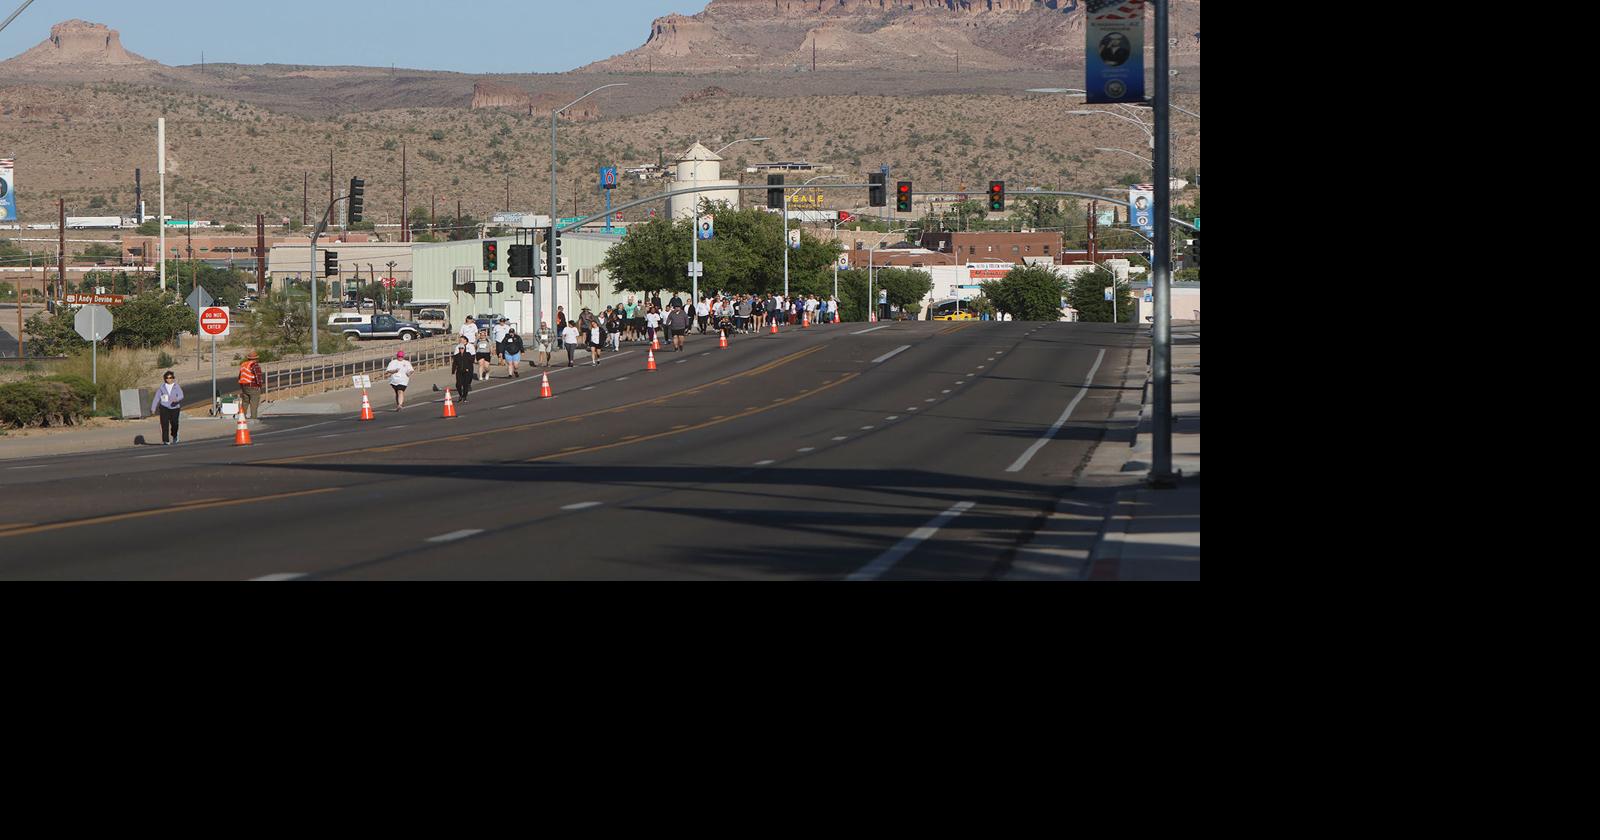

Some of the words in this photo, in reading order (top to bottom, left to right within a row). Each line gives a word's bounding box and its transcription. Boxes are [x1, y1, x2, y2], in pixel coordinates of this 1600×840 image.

[606, 168, 614, 184] 6
[78, 295, 92, 304] Andy
[94, 295, 112, 303] Devine
